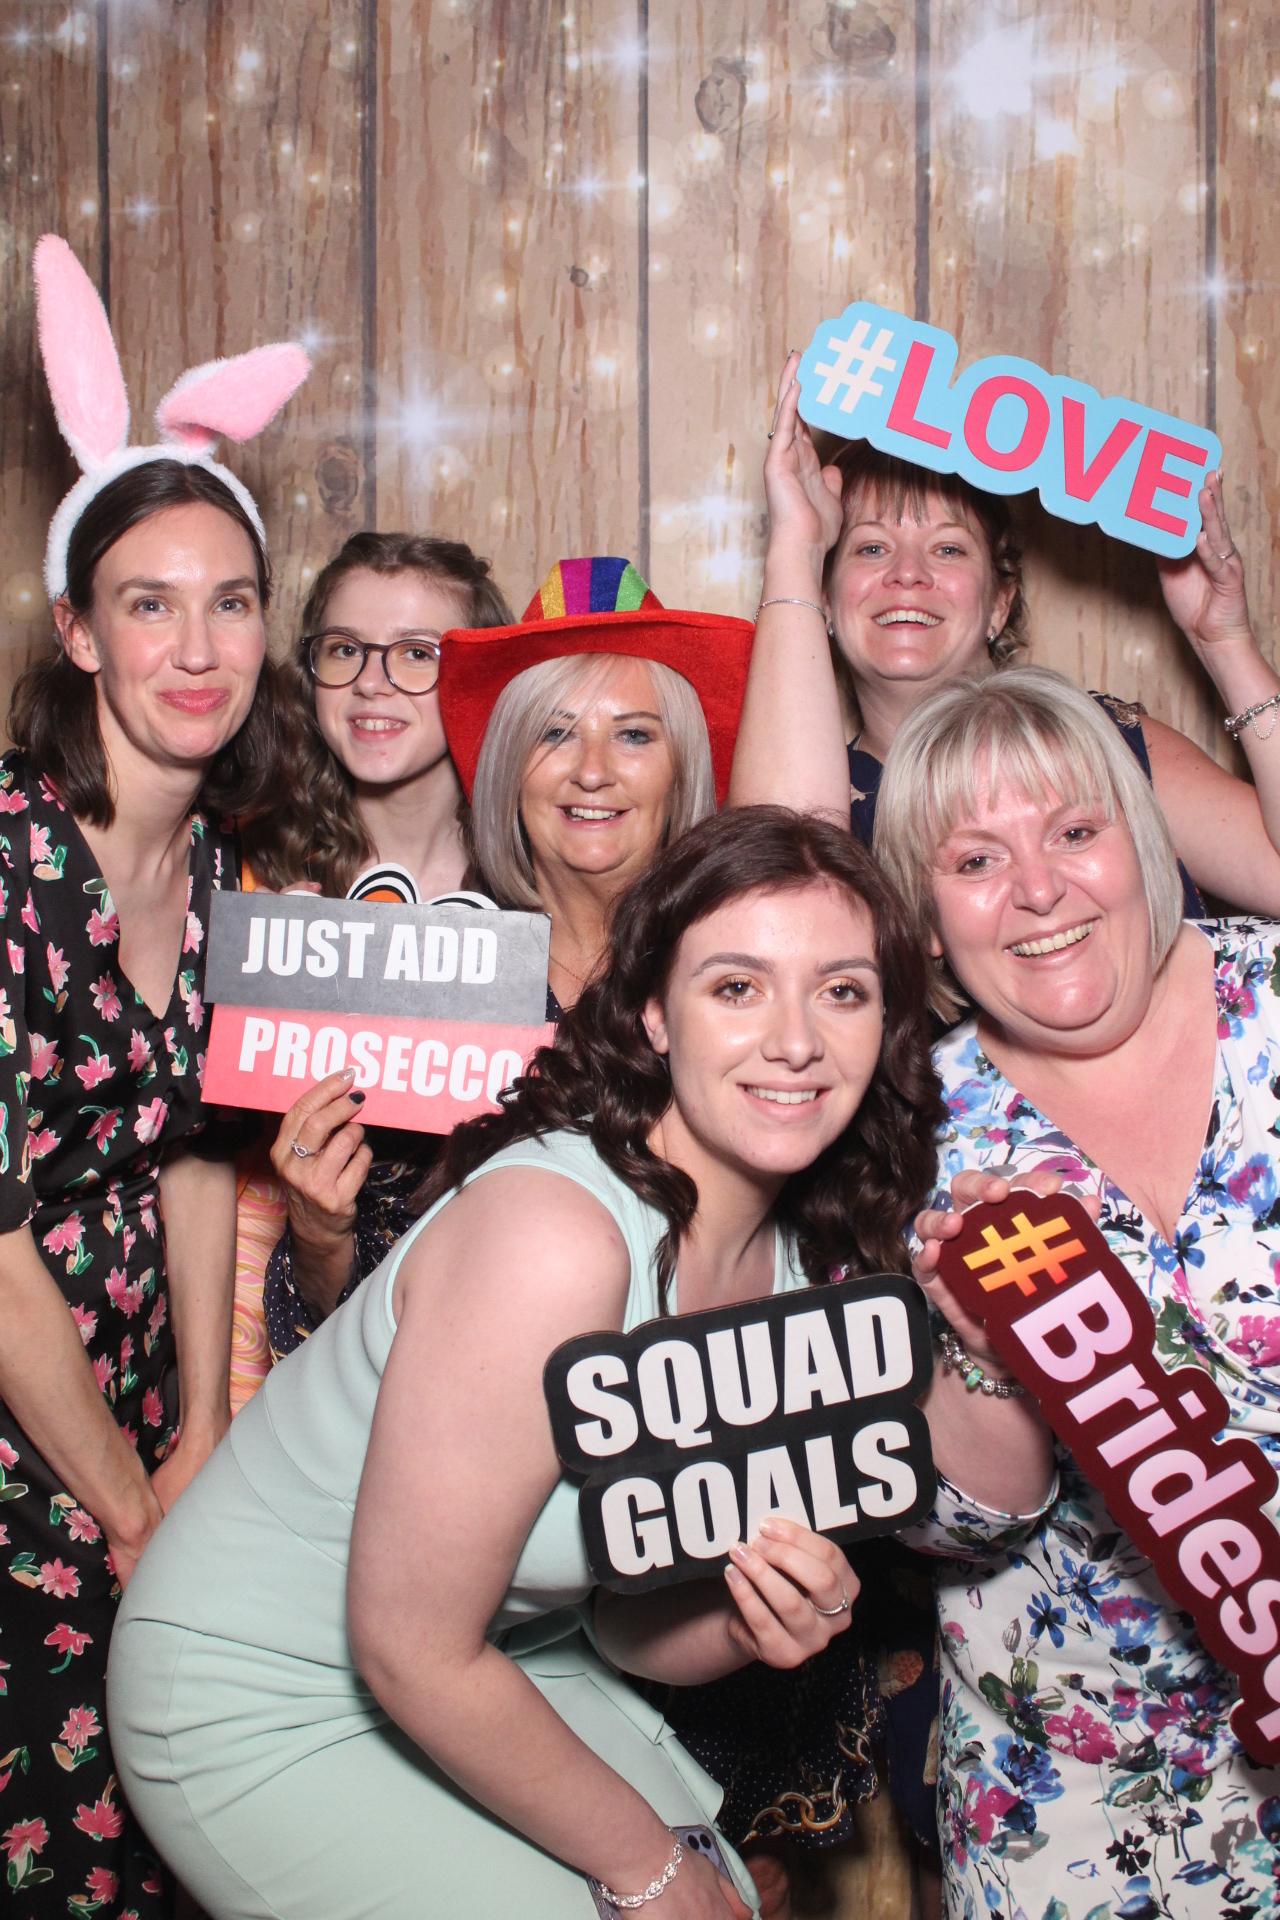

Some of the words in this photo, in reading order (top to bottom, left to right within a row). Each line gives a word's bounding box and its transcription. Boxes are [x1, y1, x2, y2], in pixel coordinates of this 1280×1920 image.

[814, 319, 1209, 538] #LOVE
[241, 917, 375, 979] JUST
[383, 923, 498, 984] ADD
[238, 1016, 523, 1105] PROSECCO
[566, 1296, 914, 1457] SQUAD
[601, 1420, 918, 1576] GOALS
